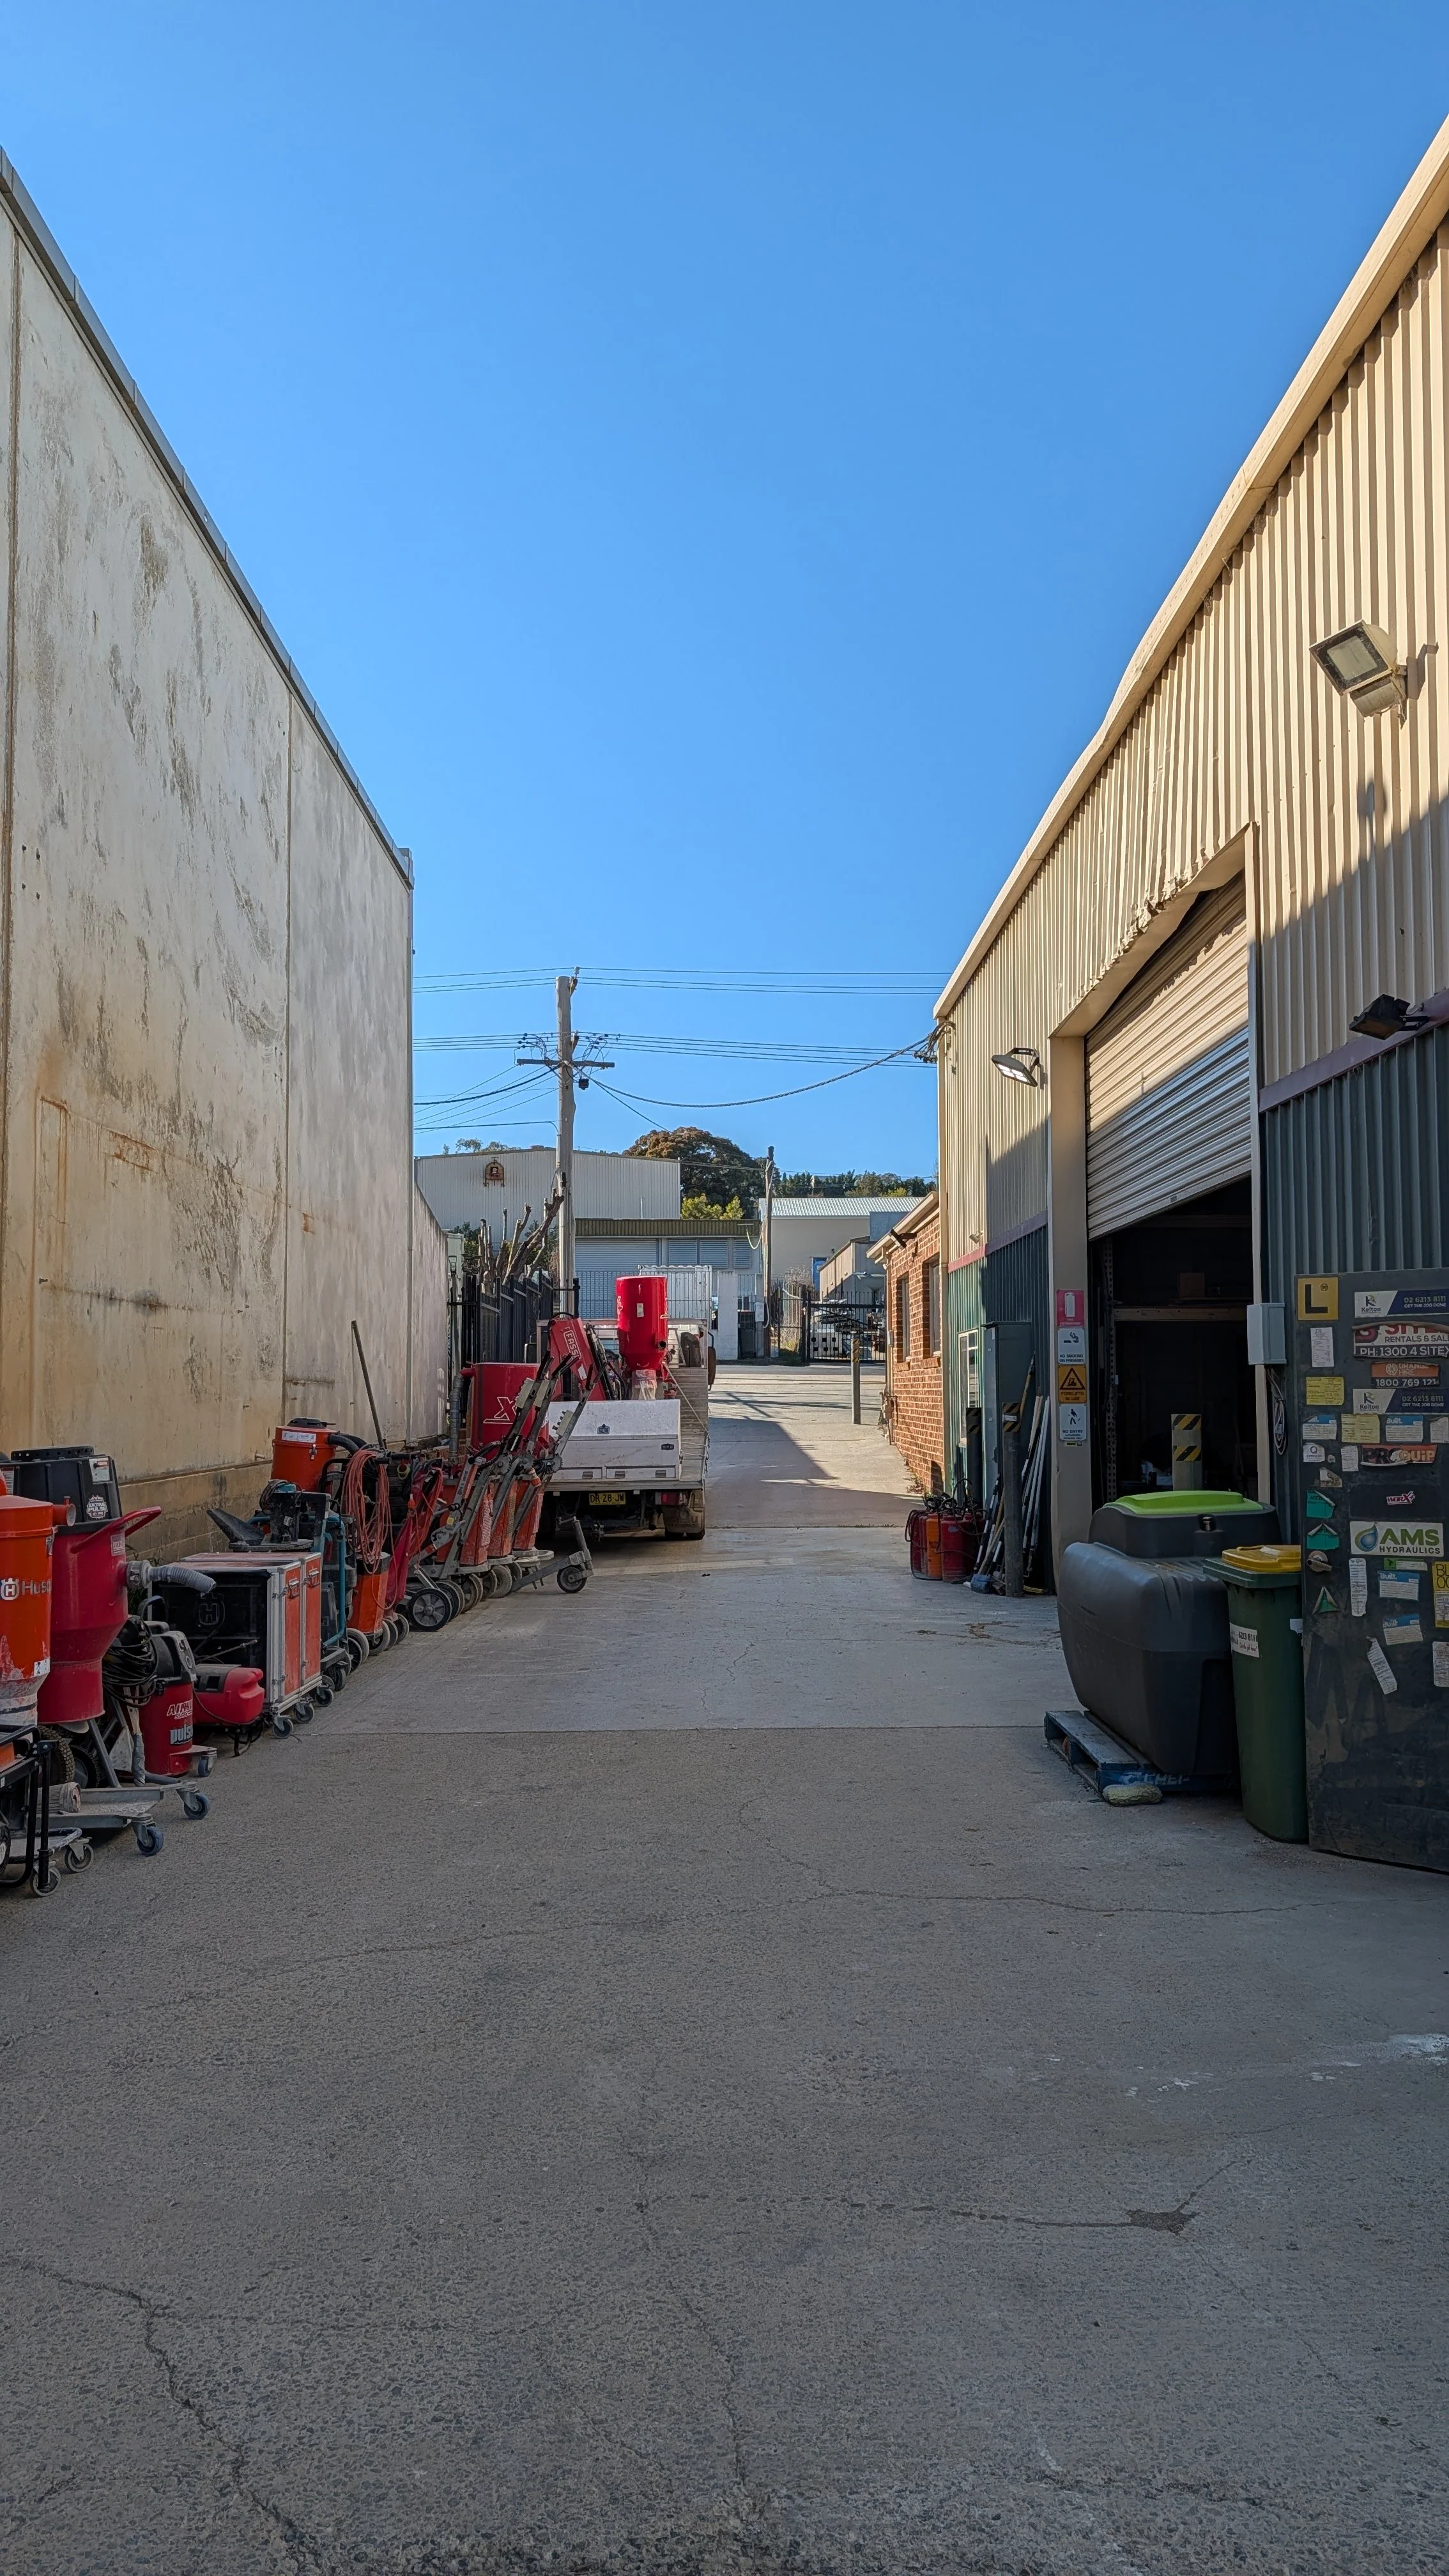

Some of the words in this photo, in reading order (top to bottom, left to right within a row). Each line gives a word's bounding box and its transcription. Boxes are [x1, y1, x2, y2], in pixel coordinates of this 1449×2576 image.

[1305, 1284, 1328, 1314] L
[1360, 1347, 1378, 1356] PH:
[1381, 1347, 1407, 1356] 1300
[1409, 1346, 1418, 1356] 4
[1376, 1378, 1399, 1386] 1800
[1402, 1378, 1420, 1386] 769
[1379, 1528, 1440, 1546] AMS
[1379, 1545, 1441, 1554] HYDRAULICS
